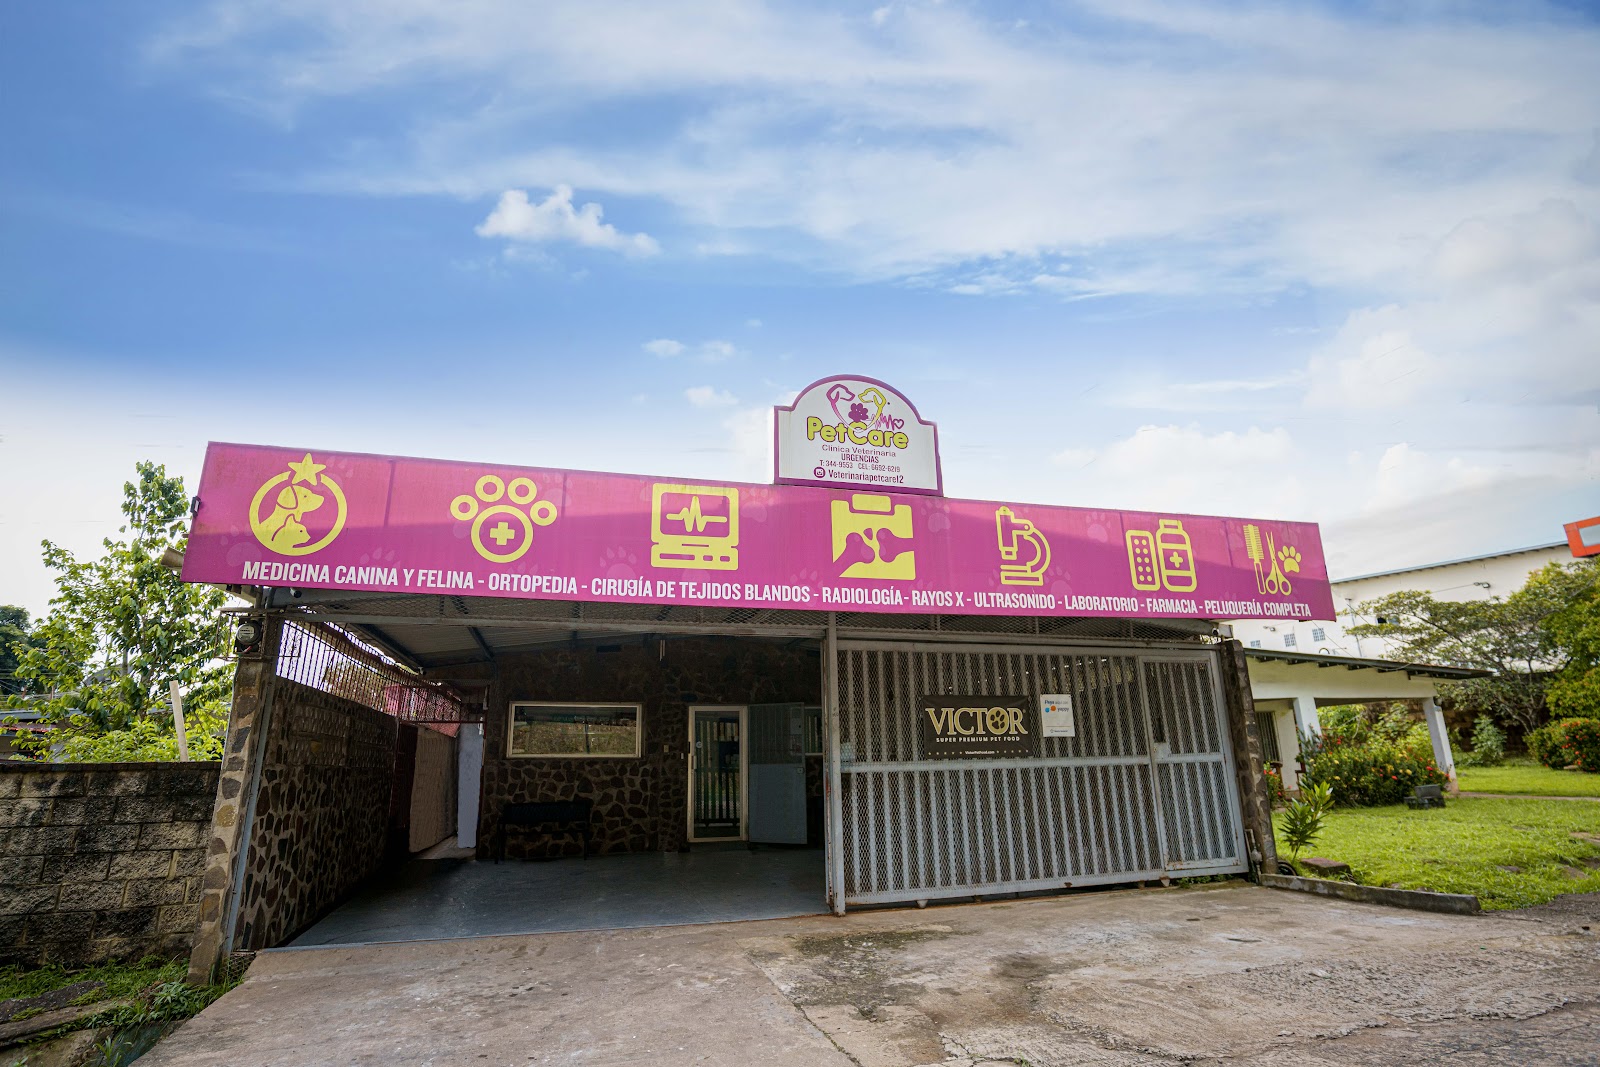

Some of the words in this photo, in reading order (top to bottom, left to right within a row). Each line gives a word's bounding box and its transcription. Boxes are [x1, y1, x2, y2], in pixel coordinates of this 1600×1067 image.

[806, 416, 909, 449] PetCare
[841, 454, 880, 464] URGENCIAS
[852, 446, 896, 457] Veterinaria
[242, 561, 330, 582] MEDICINA
[334, 565, 398, 586] CANINA
[403, 568, 415, 586] Y
[417, 569, 474, 589] FELINA
[488, 572, 578, 594] ORTOPEDIA
[656, 580, 676, 598] DE
[679, 581, 741, 600] TEJIDOS
[744, 583, 810, 603] BLANDOS
[822, 586, 903, 606] RADIOLOGÍA
[912, 590, 953, 606] RAYOS
[955, 592, 964, 607] X
[974, 592, 1056, 610] ULTRASONIDO
[1065, 595, 1138, 612] LABORATORIO
[1146, 598, 1198, 614] FARMACIA
[1204, 598, 1262, 616] PELUQUERÍA
[1264, 602, 1312, 617] COMPLETA
[925, 707, 1028, 736] VICTOR
